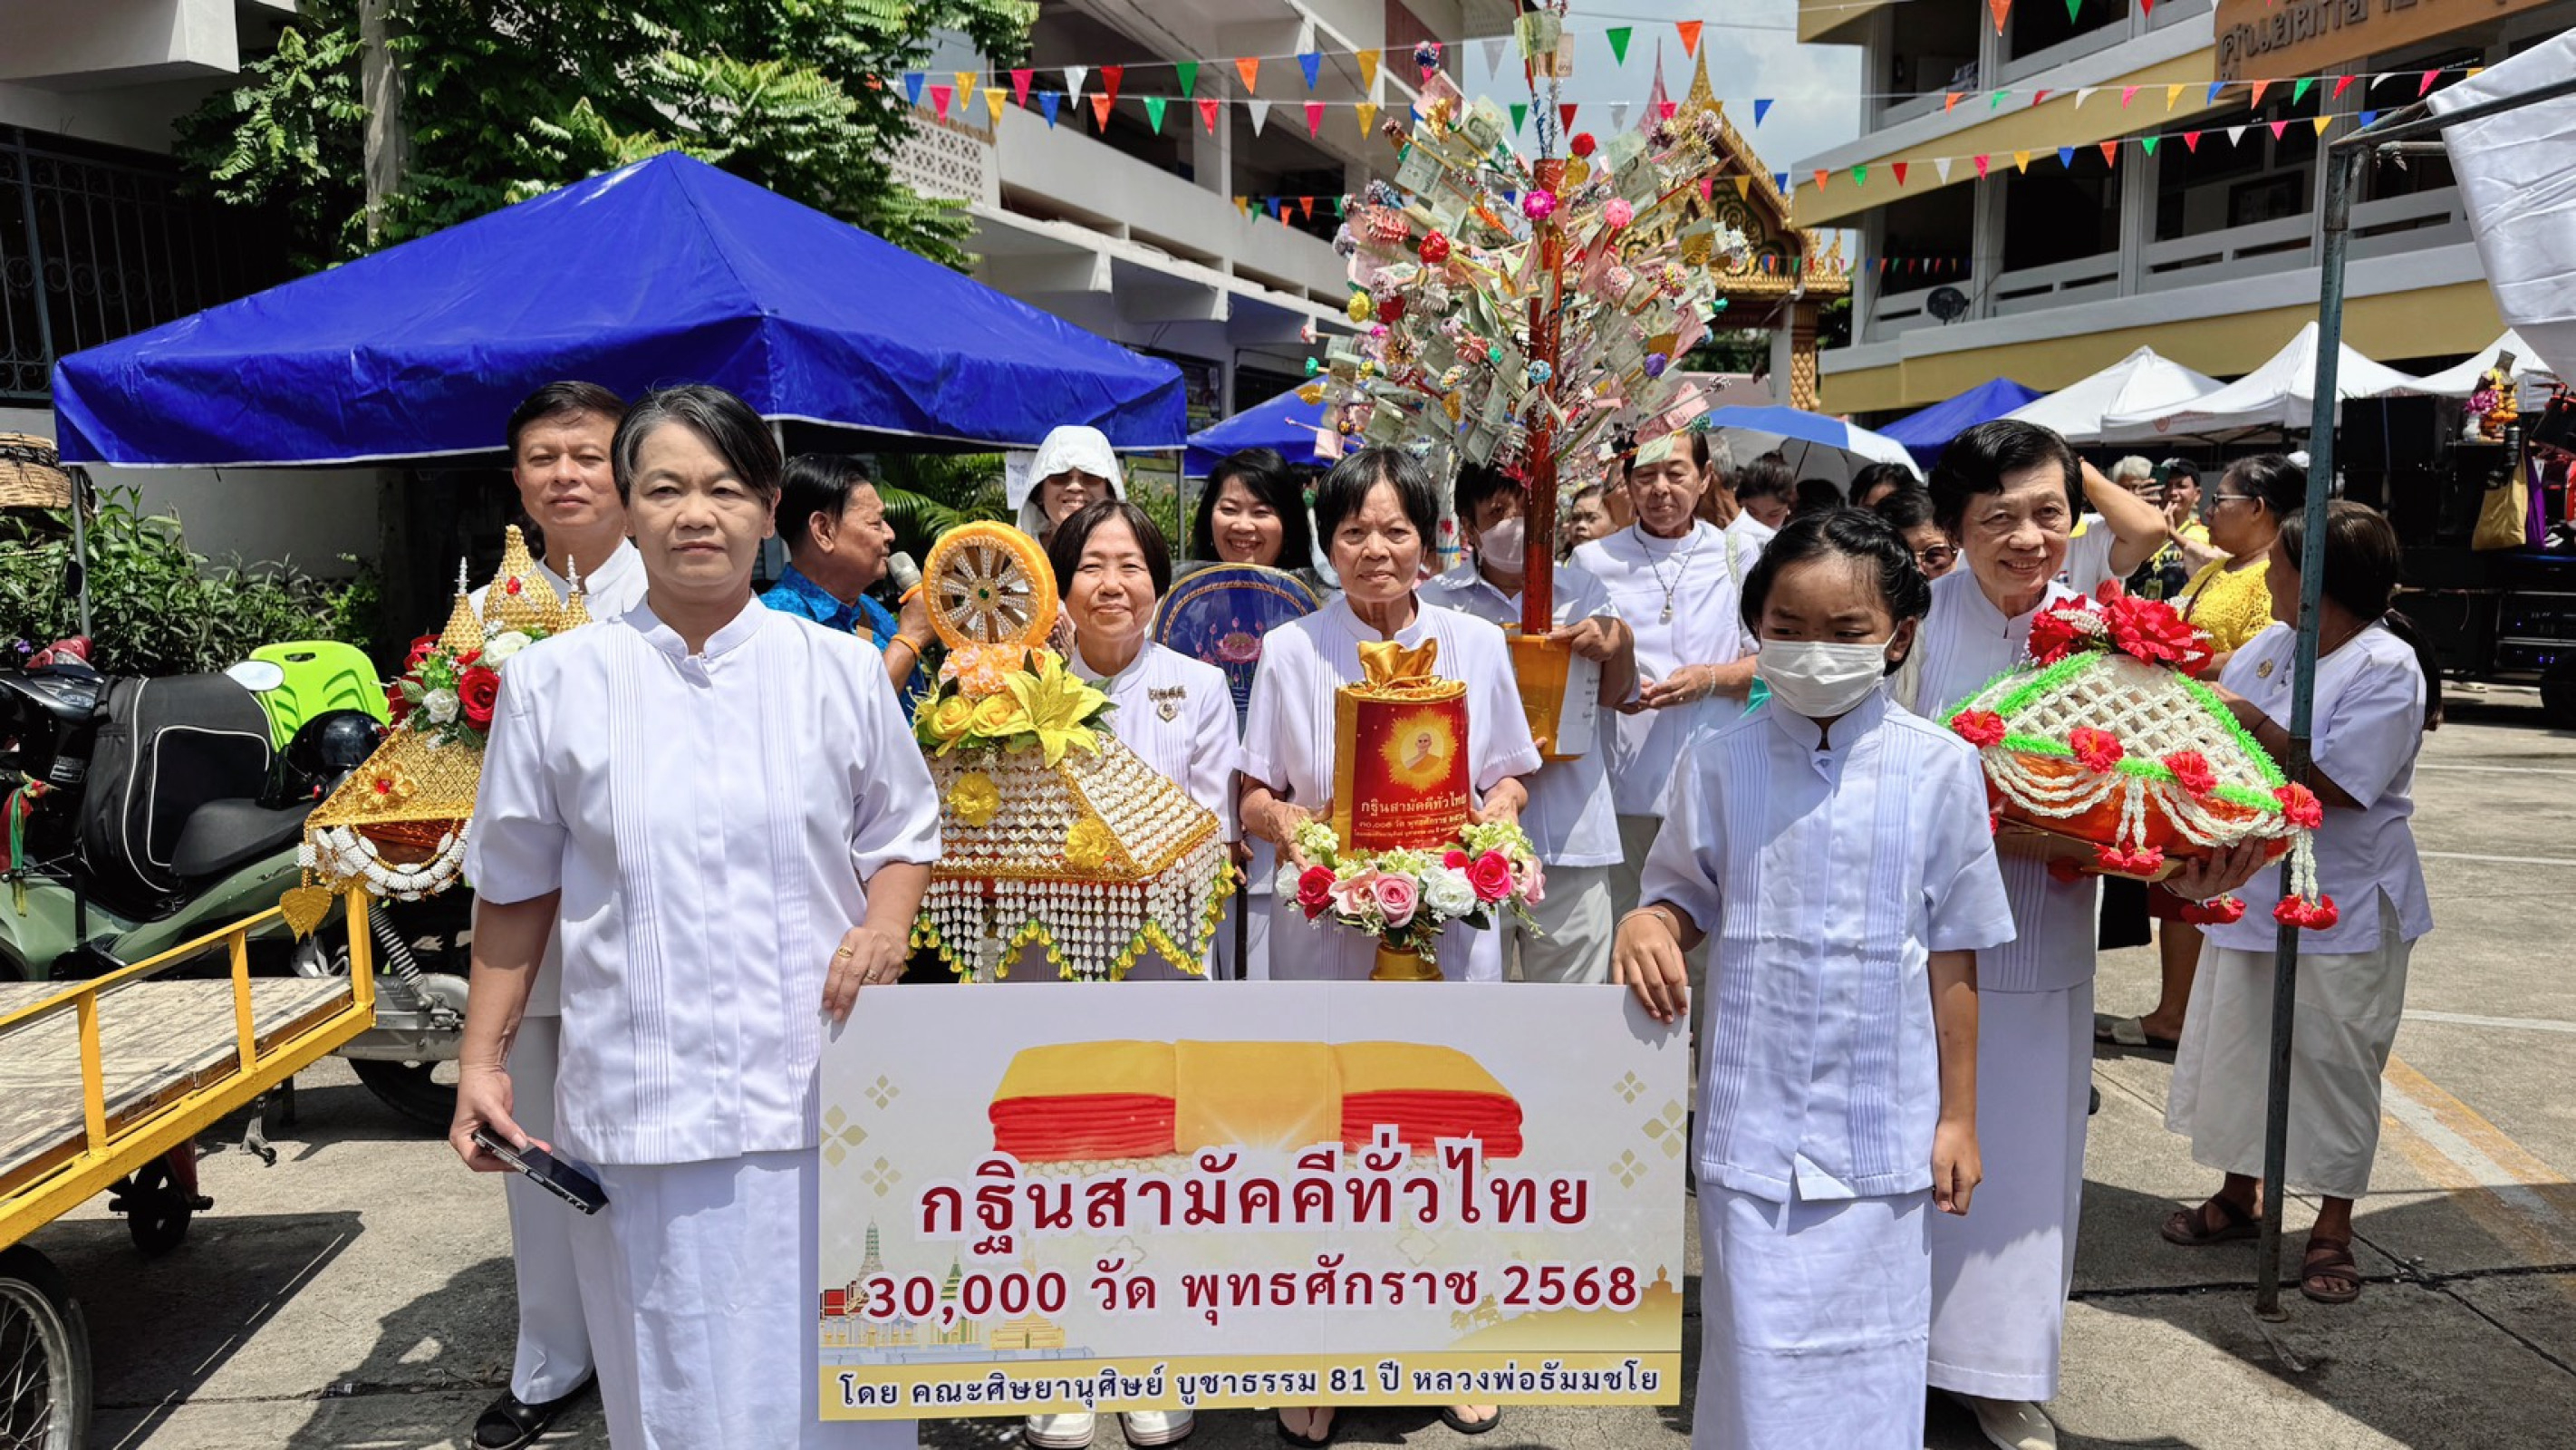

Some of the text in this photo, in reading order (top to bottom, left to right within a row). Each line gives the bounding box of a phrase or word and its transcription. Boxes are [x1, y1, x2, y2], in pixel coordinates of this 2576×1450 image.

[921, 1133, 1587, 1255] กฐินสามัคคีทั่วไทย
[867, 1253, 1636, 1326] 30,000 วัด พุทธศักราช 2568
[839, 1361, 1657, 1407] โดย คณะศิษยานุศิษย์ บูชาธรรม 81 ปี หลวงพ่อธัมมชโย
